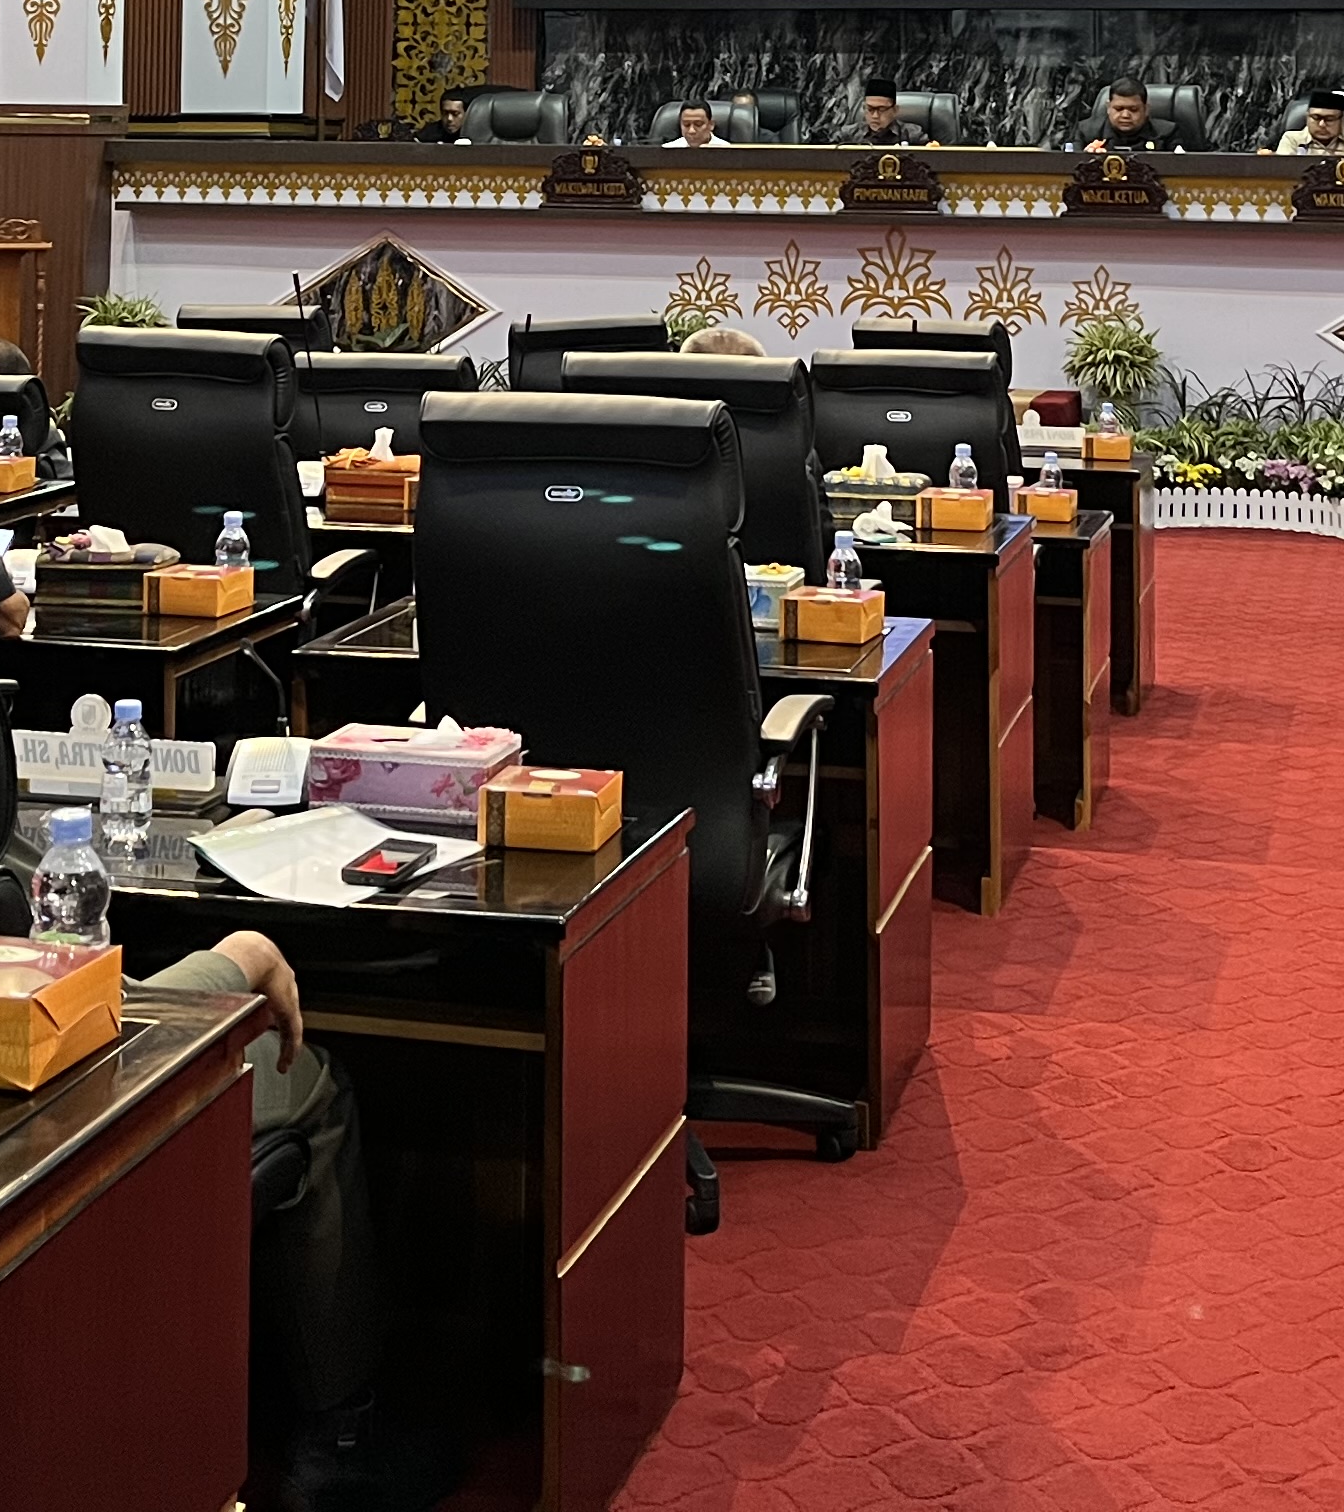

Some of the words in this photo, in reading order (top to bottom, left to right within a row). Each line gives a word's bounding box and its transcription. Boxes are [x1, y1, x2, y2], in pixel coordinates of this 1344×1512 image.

[853, 188, 901, 201] PIMPINAN
[1080, 189, 1114, 204] WAKIL
[1115, 190, 1150, 204] KETUA
